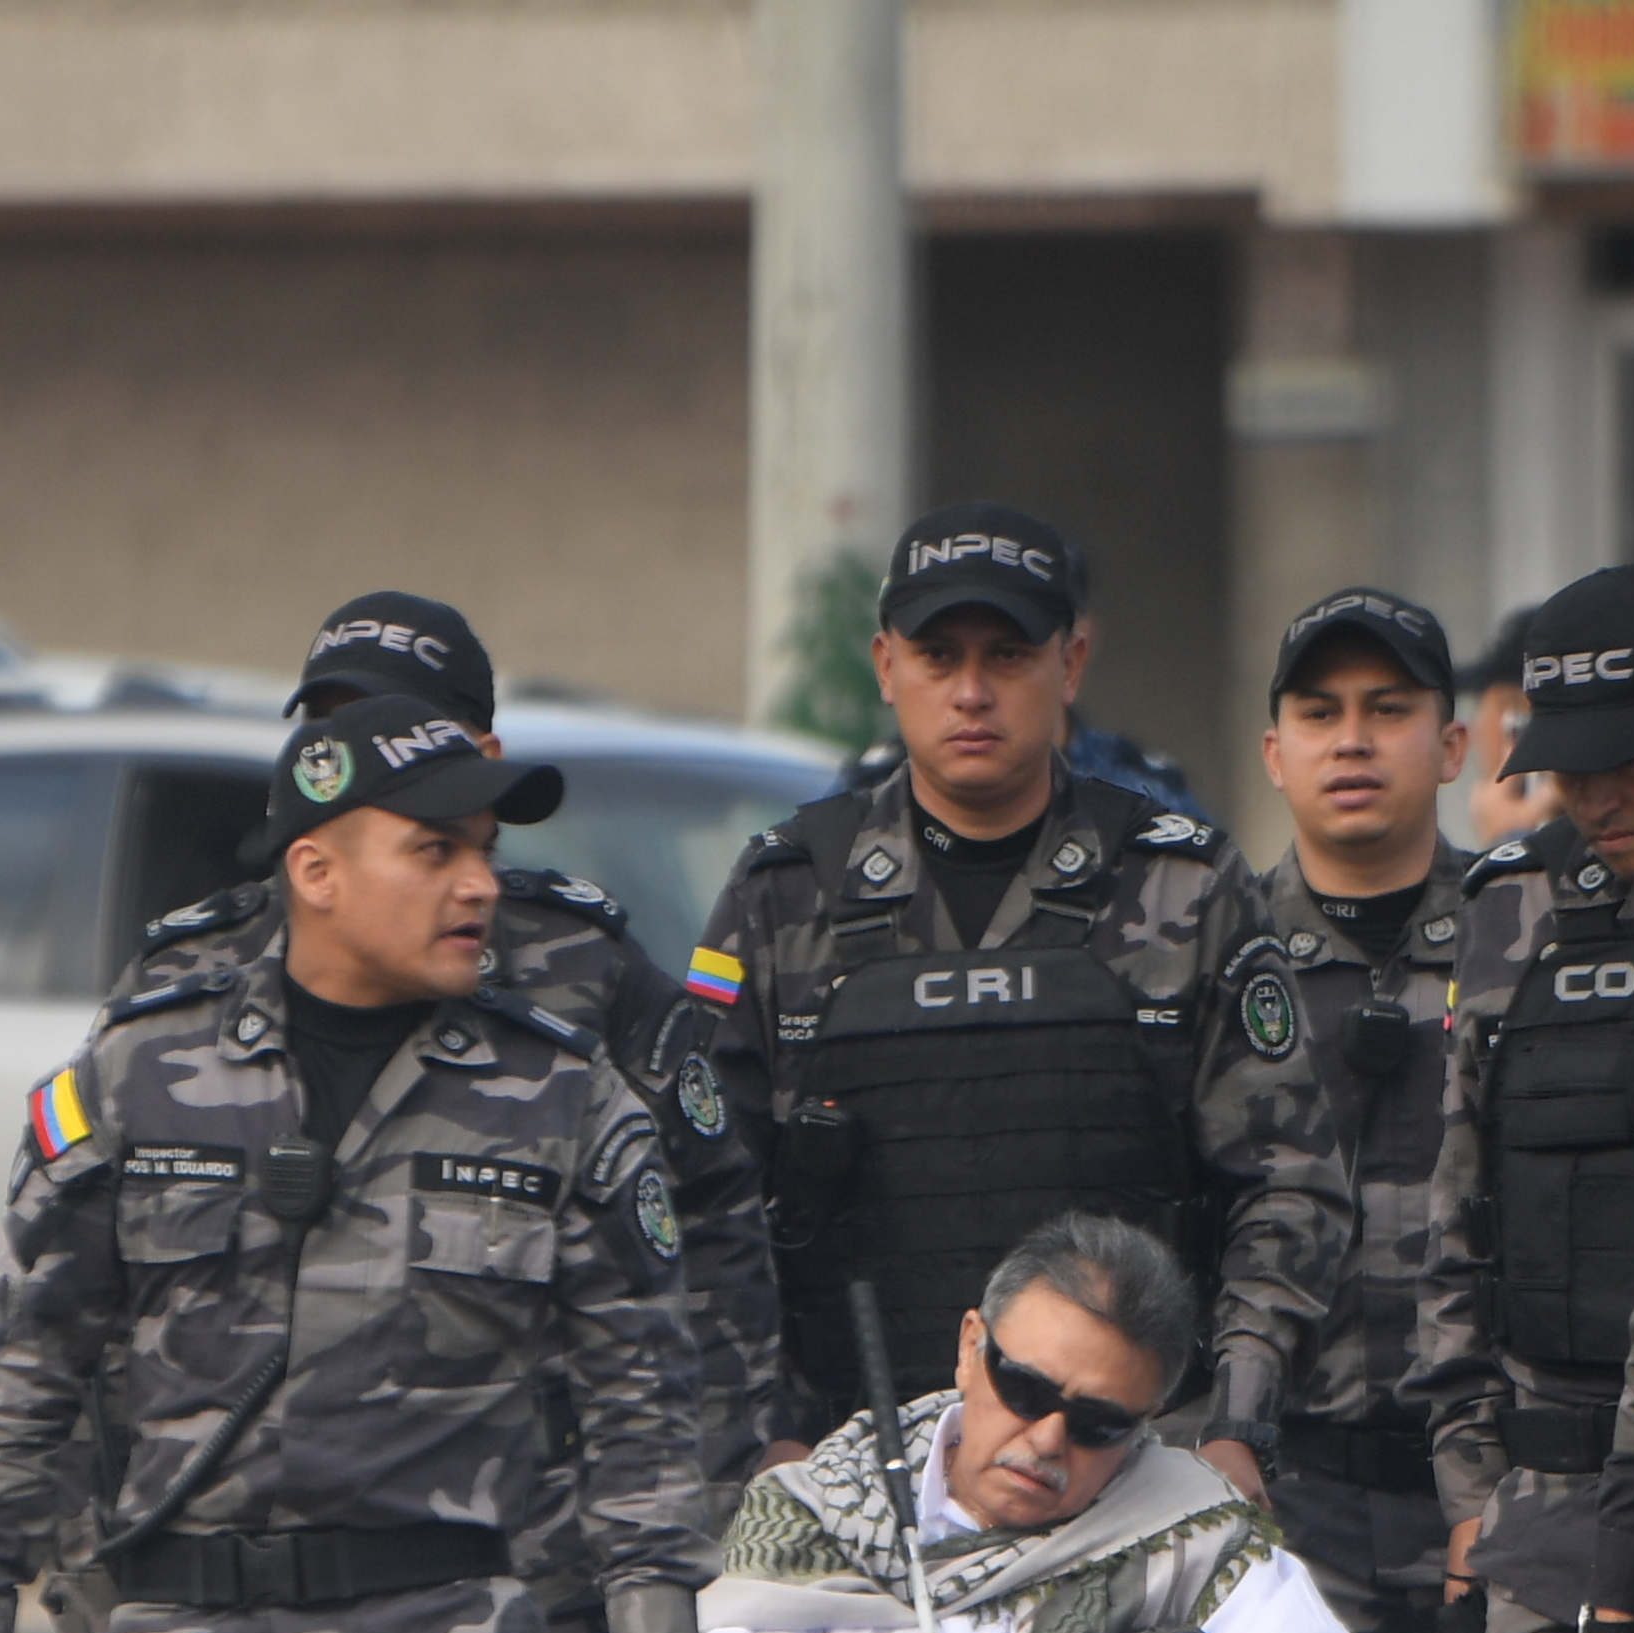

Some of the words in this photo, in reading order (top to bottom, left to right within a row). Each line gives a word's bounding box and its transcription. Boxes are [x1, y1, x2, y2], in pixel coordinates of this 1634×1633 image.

[923, 826, 951, 852] CRI
[1321, 902, 1358, 919] CRI
[913, 965, 1034, 1008] CRI
[1136, 1008, 1180, 1024] EC
